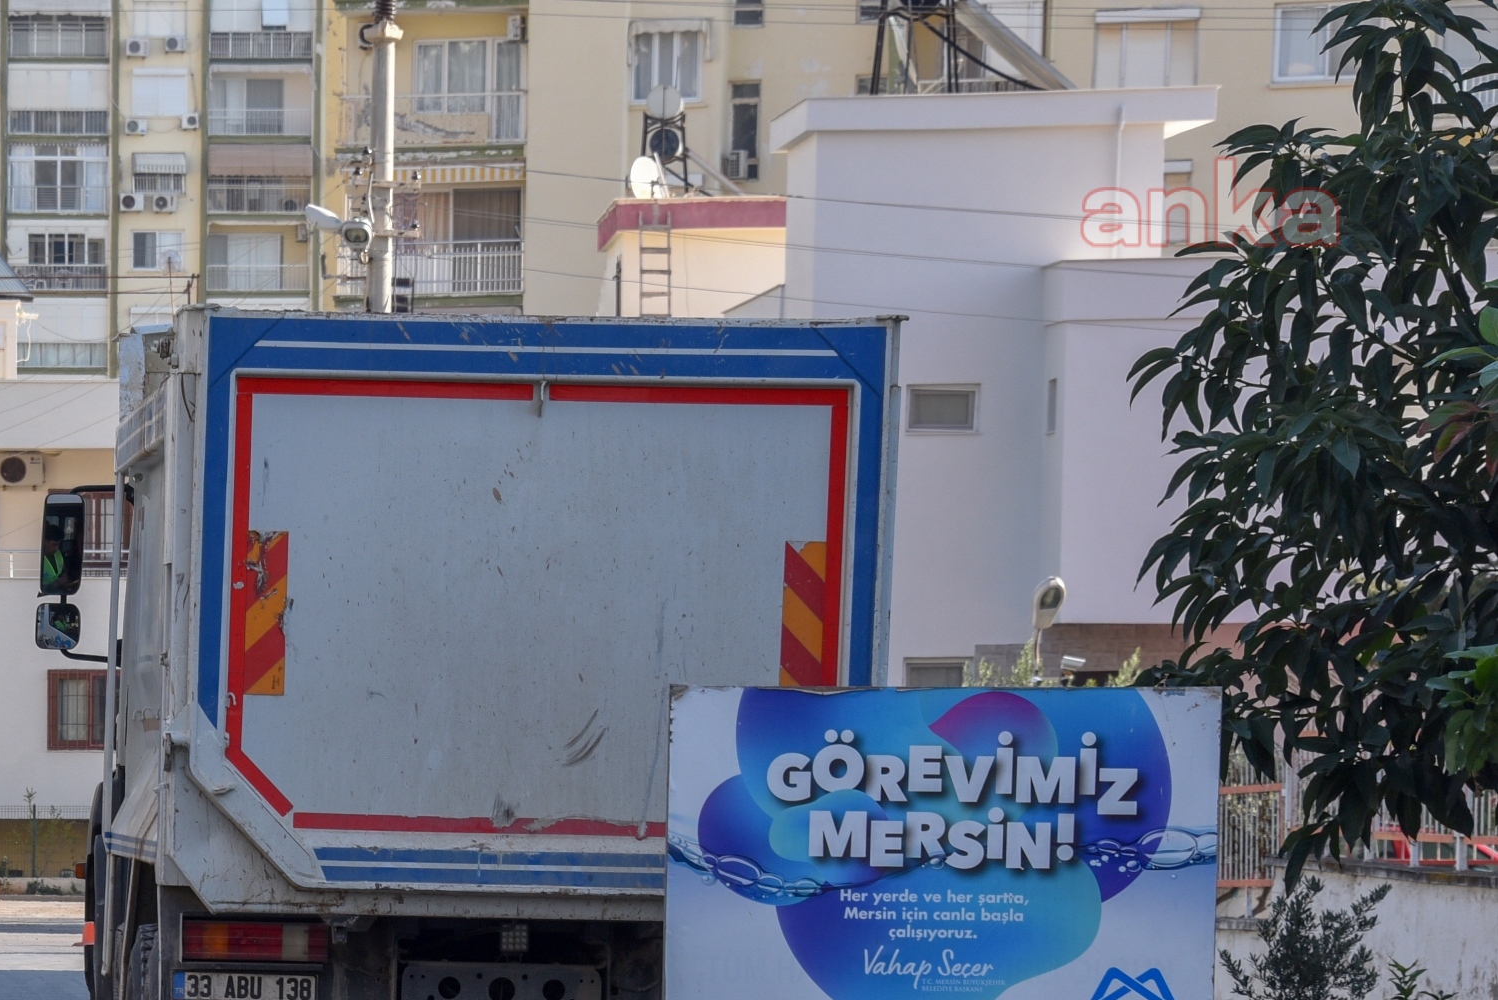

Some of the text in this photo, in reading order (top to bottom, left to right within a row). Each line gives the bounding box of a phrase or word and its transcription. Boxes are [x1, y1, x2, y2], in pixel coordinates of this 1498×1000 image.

[766, 728, 1139, 816] GÖREVİMİZ
[807, 806, 1076, 870] MERSİN!
[839, 888, 1030, 907] Her yerde ve her şartta,
[843, 906, 1024, 925] Mersin için canla başla
[888, 924, 978, 943] çalışıyoruz.
[863, 944, 994, 990] Vahap Seçer
[174, 987, 184, 995] TR
[186, 974, 312, 1000] 33 ABU 138
[935, 977, 961, 986] MERSİN
[962, 977, 1006, 987] BÜYÜKŞEHİR
